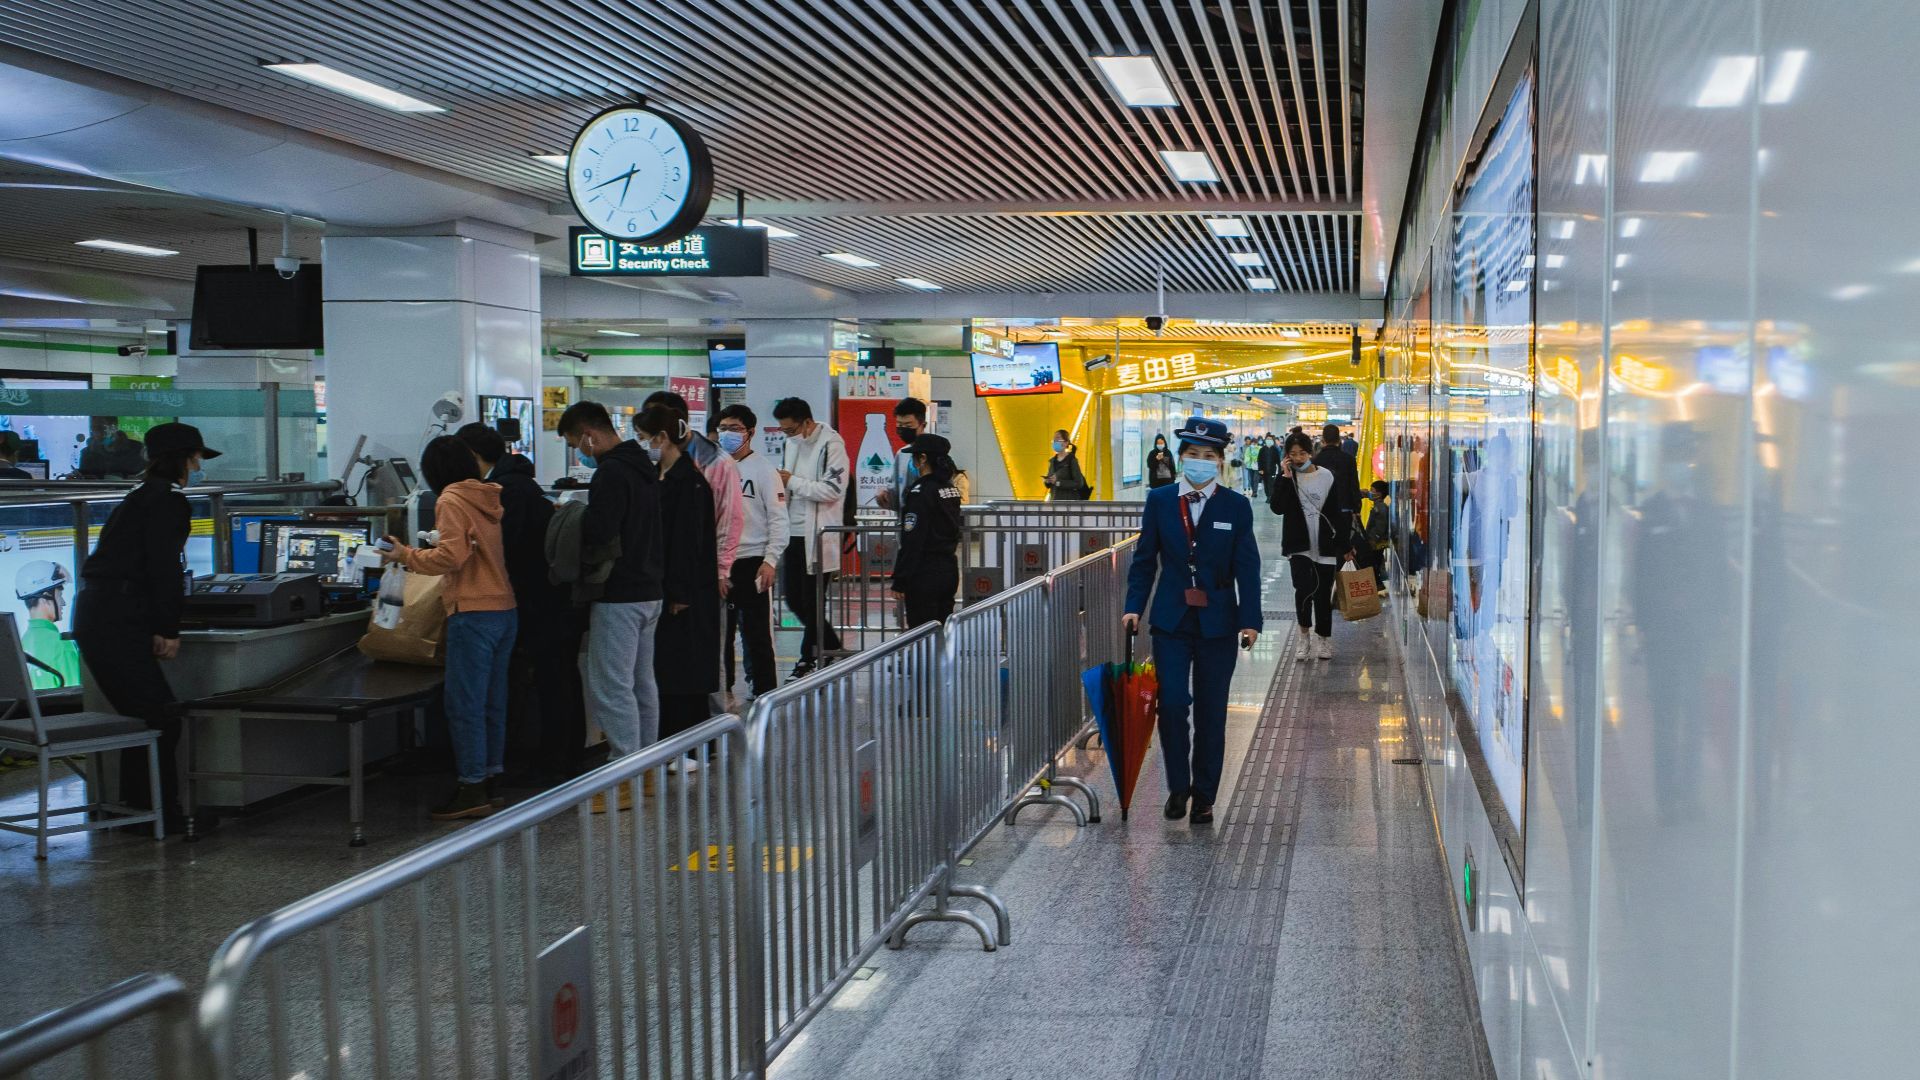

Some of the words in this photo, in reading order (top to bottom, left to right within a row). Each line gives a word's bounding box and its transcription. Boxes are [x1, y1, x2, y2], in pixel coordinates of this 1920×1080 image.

[623, 117, 639, 132] 12
[583, 168, 593, 183] 9
[671, 166, 681, 182] 3
[627, 217, 637, 233] 6
[618, 259, 669, 271] Security
[671, 259, 709, 269] Check
[1115, 352, 1198, 388] 麦田里
[1193, 369, 1274, 391] 地铁商业街
